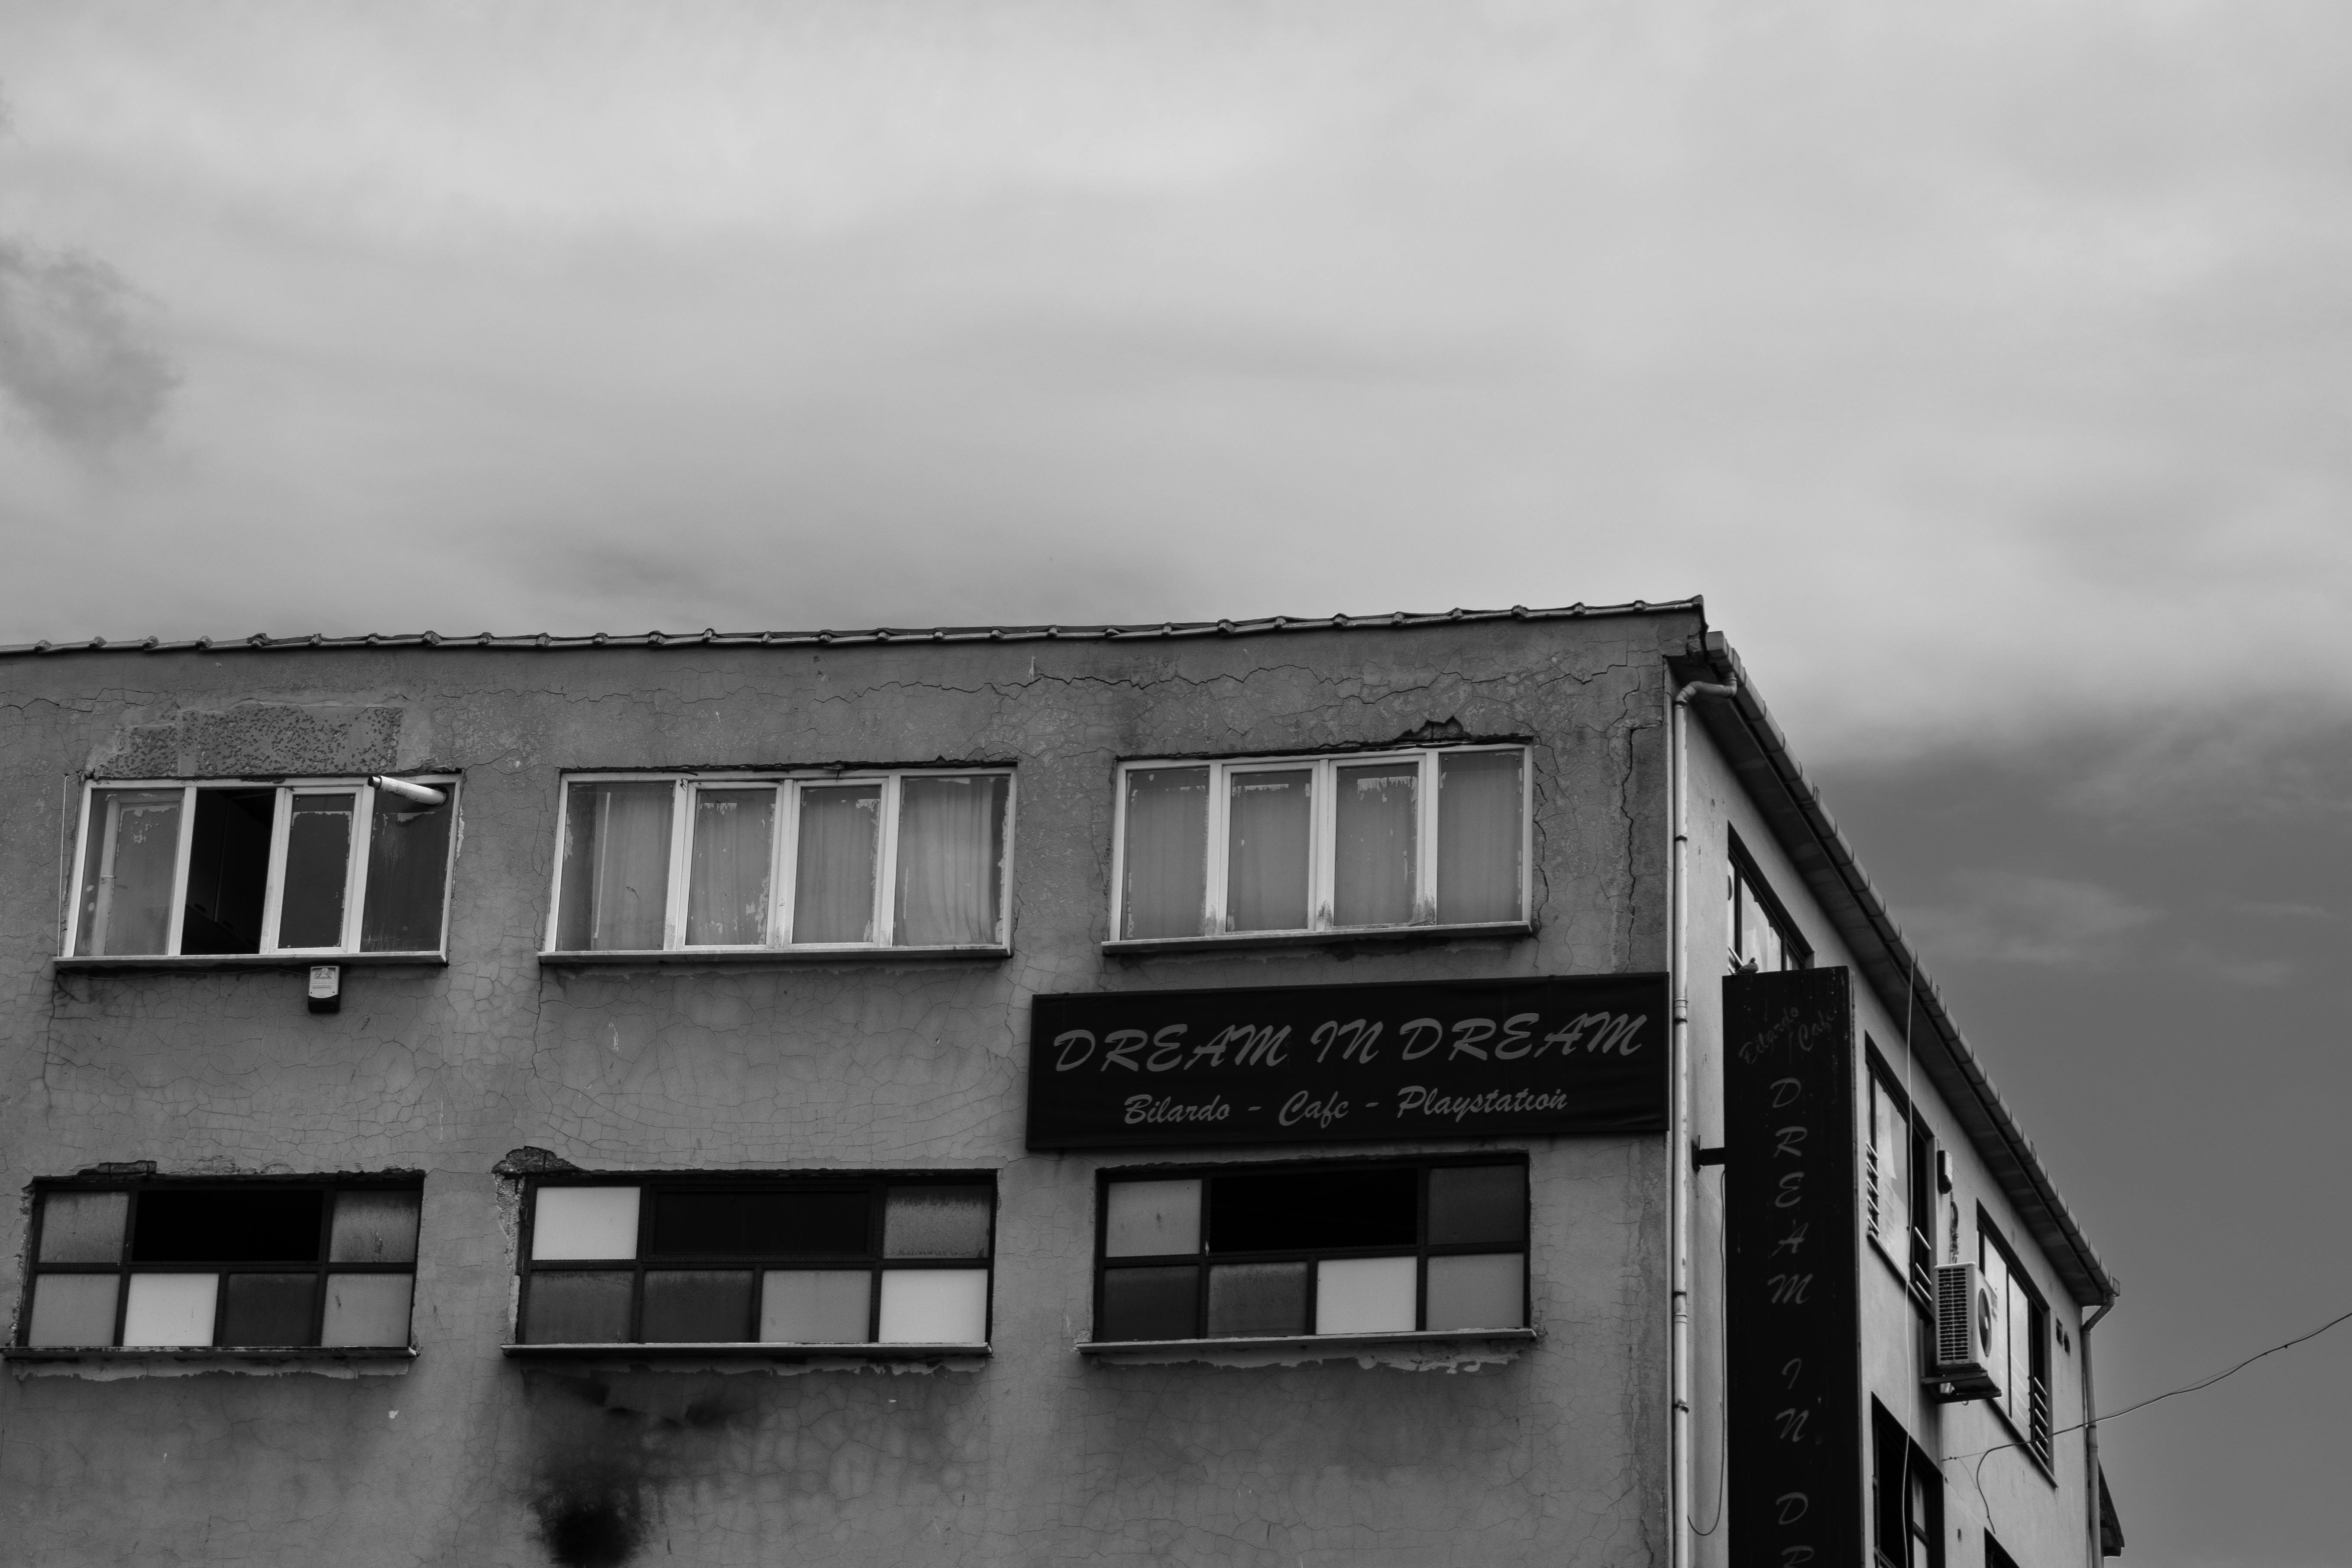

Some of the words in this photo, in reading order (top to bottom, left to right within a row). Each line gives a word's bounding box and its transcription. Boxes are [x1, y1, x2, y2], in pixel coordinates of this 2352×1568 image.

[1053, 1024, 1292, 1072] DREAM
[1310, 1018, 1384, 1064] IN
[1399, 1012, 1648, 1061] DREAM
[1123, 1093, 1231, 1125] Bilardo
[1397, 1086, 1568, 1123] Playstation
[1766, 1077, 1814, 1305] DREAM
[1775, 1357, 1810, 1442] IN
